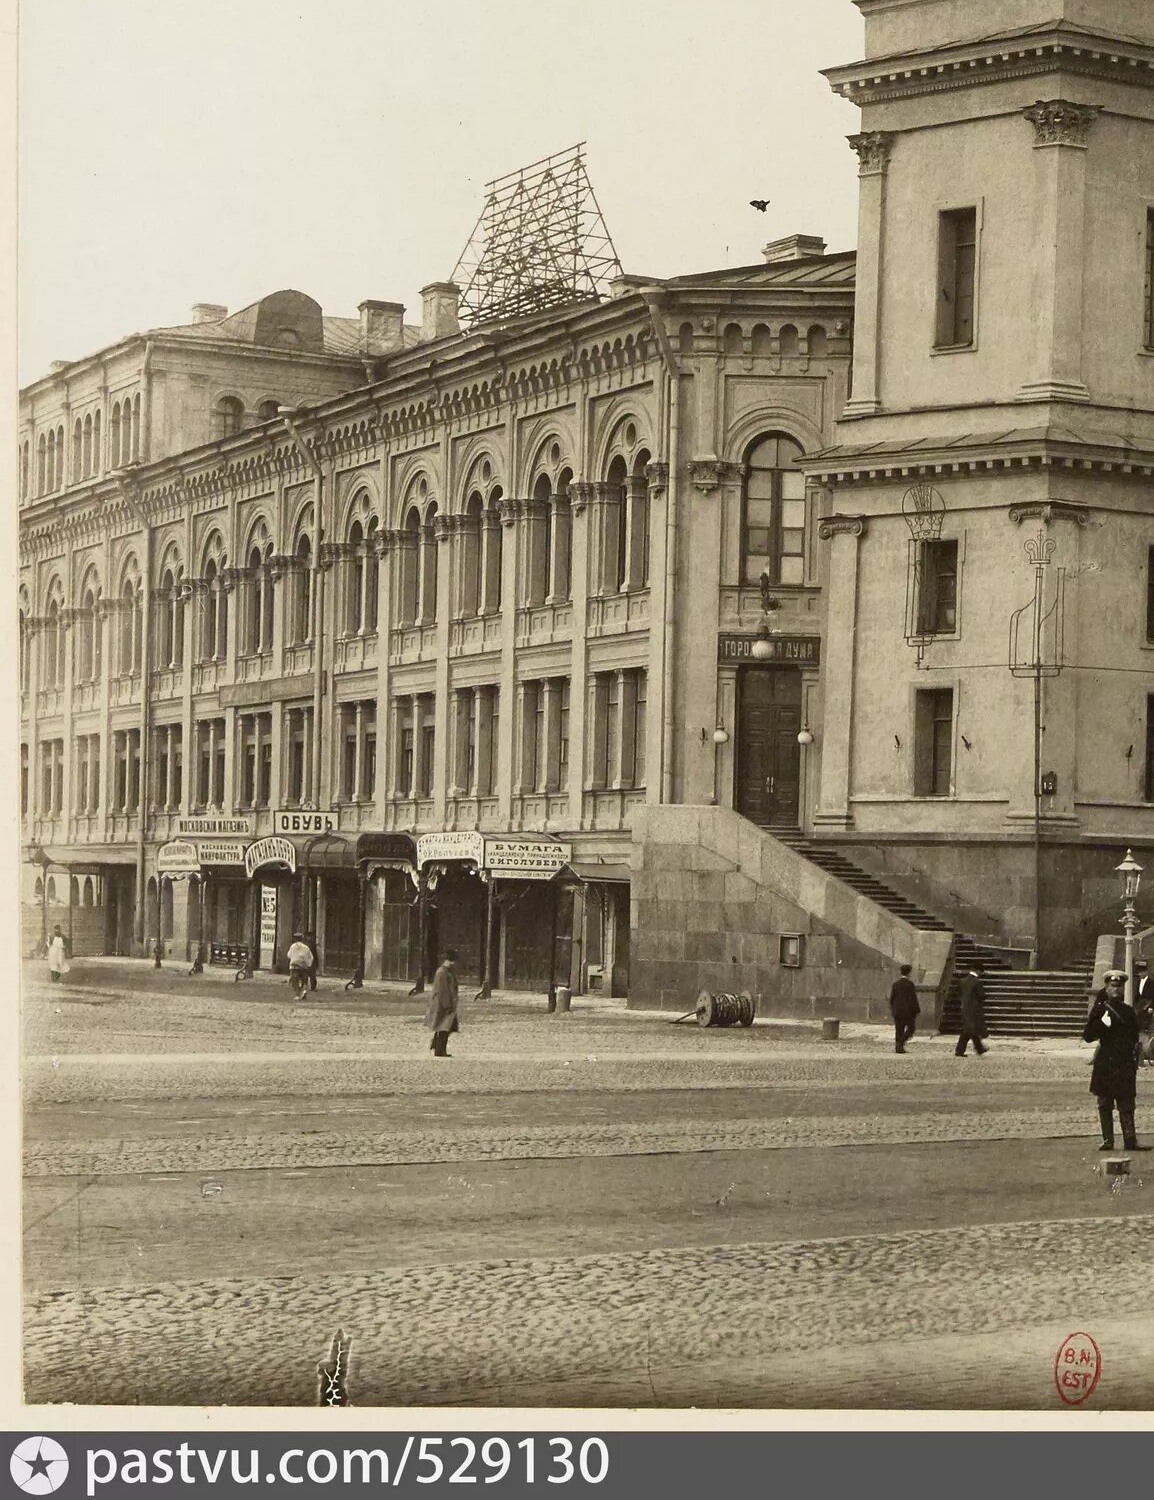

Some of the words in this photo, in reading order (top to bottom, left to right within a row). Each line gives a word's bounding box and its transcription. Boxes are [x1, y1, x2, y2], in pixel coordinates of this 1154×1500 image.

[786, 642, 813, 658] ДУМА
[218, 820, 249, 833] МАГАЗИНЪ
[281, 815, 333, 831] ОБУВЬ
[494, 844, 563, 852] БУМАГА
[200, 851, 241, 862] МАНУФАКТУРА
